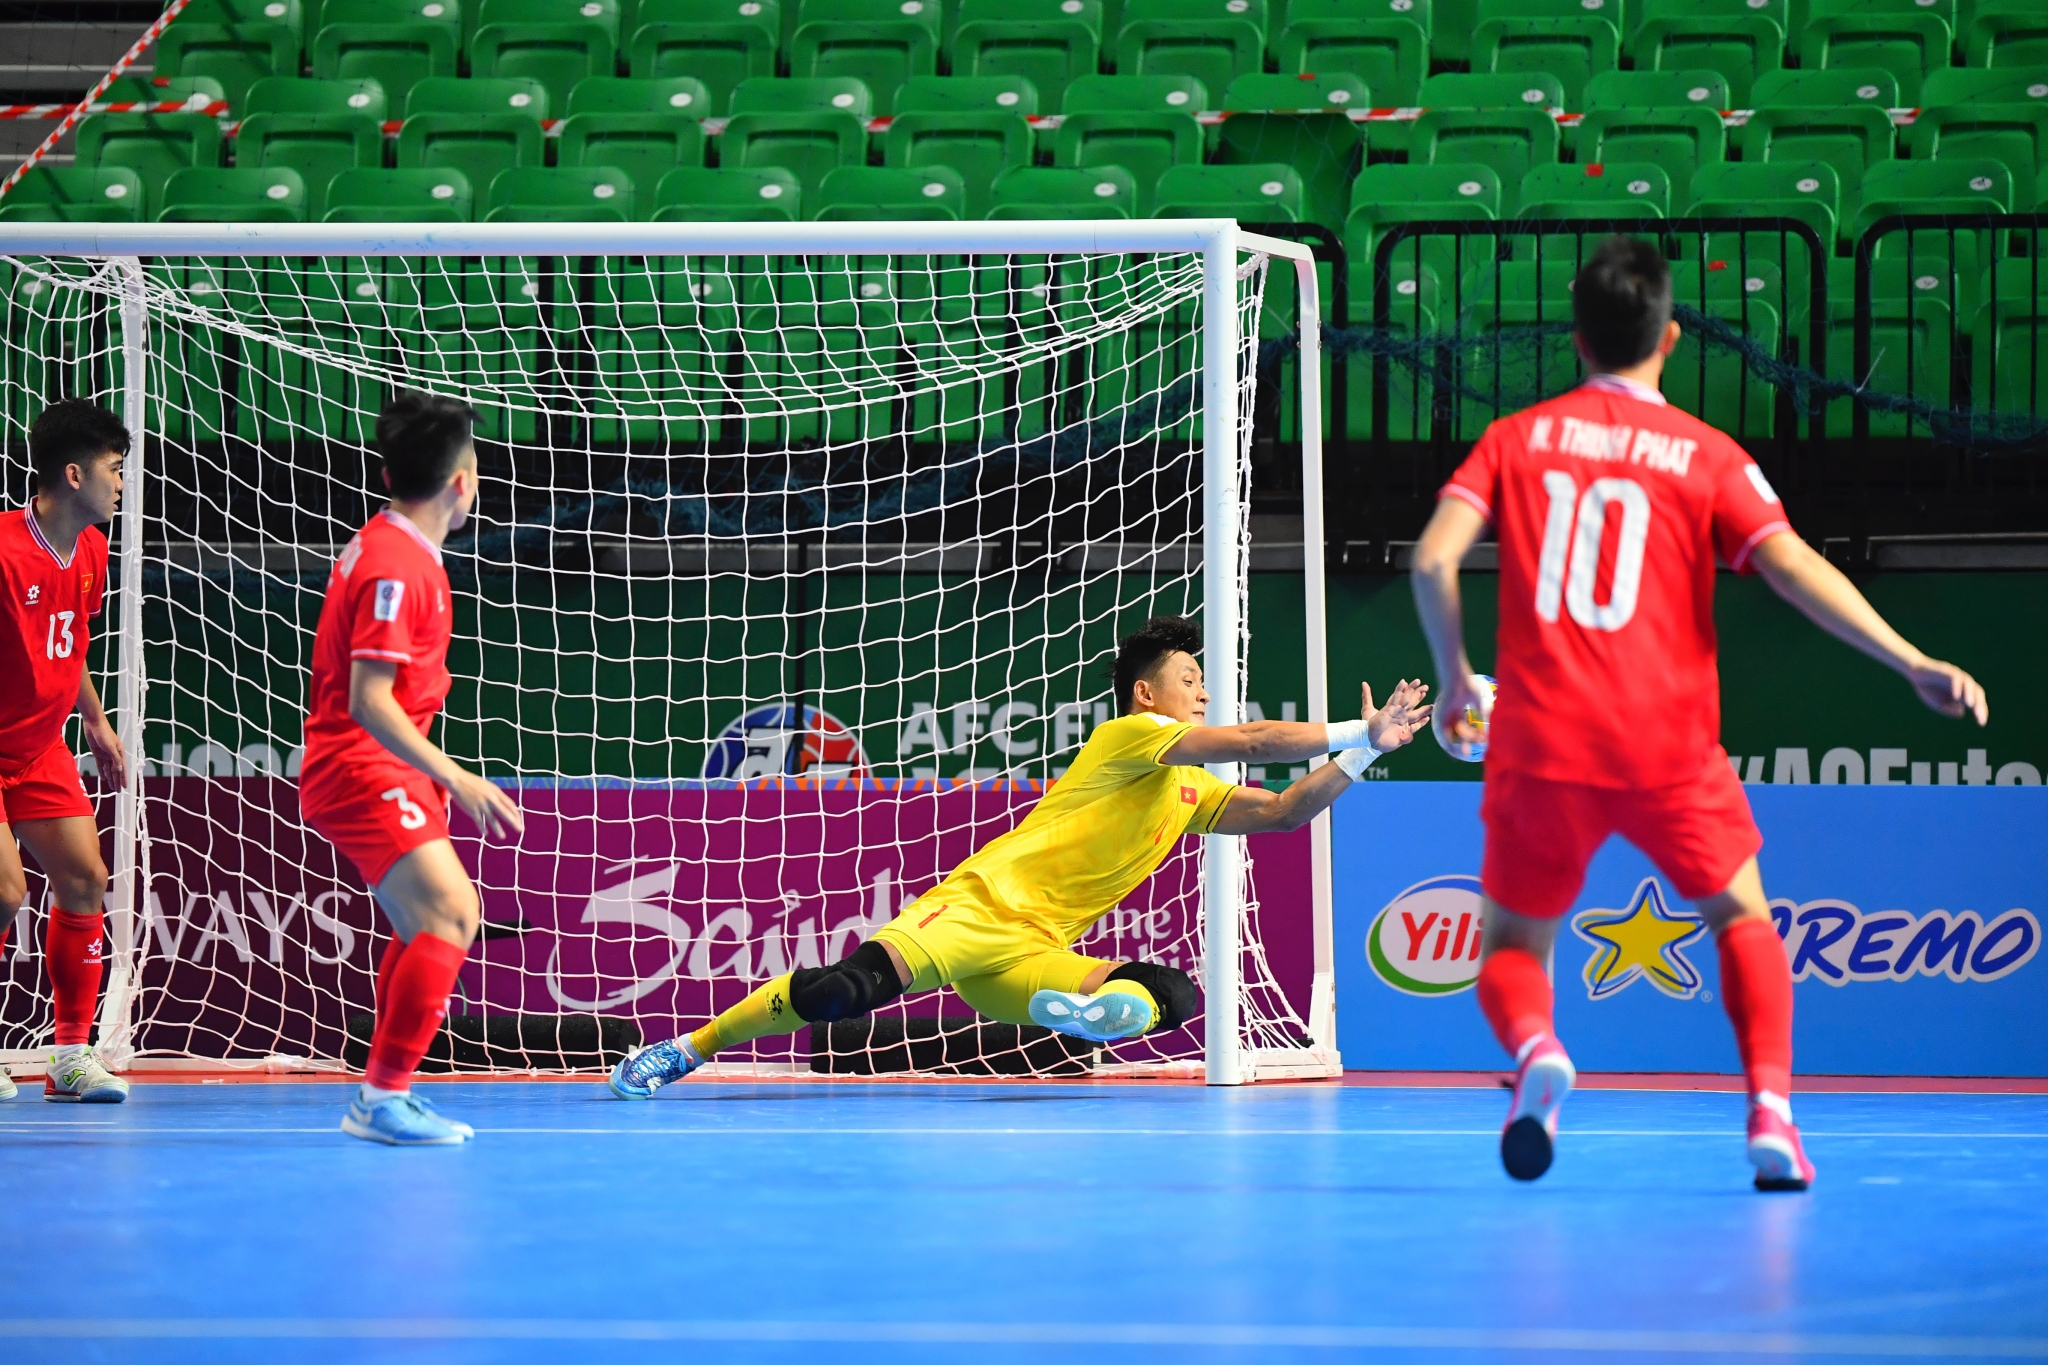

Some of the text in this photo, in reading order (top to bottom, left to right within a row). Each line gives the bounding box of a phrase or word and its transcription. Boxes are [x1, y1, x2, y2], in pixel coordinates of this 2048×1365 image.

[1535, 470, 1651, 632] 10
[46, 610, 75, 660] 13
[896, 702, 1038, 757] AFC
[381, 786, 427, 830] 3
[1401, 912, 1484, 961] Yili
